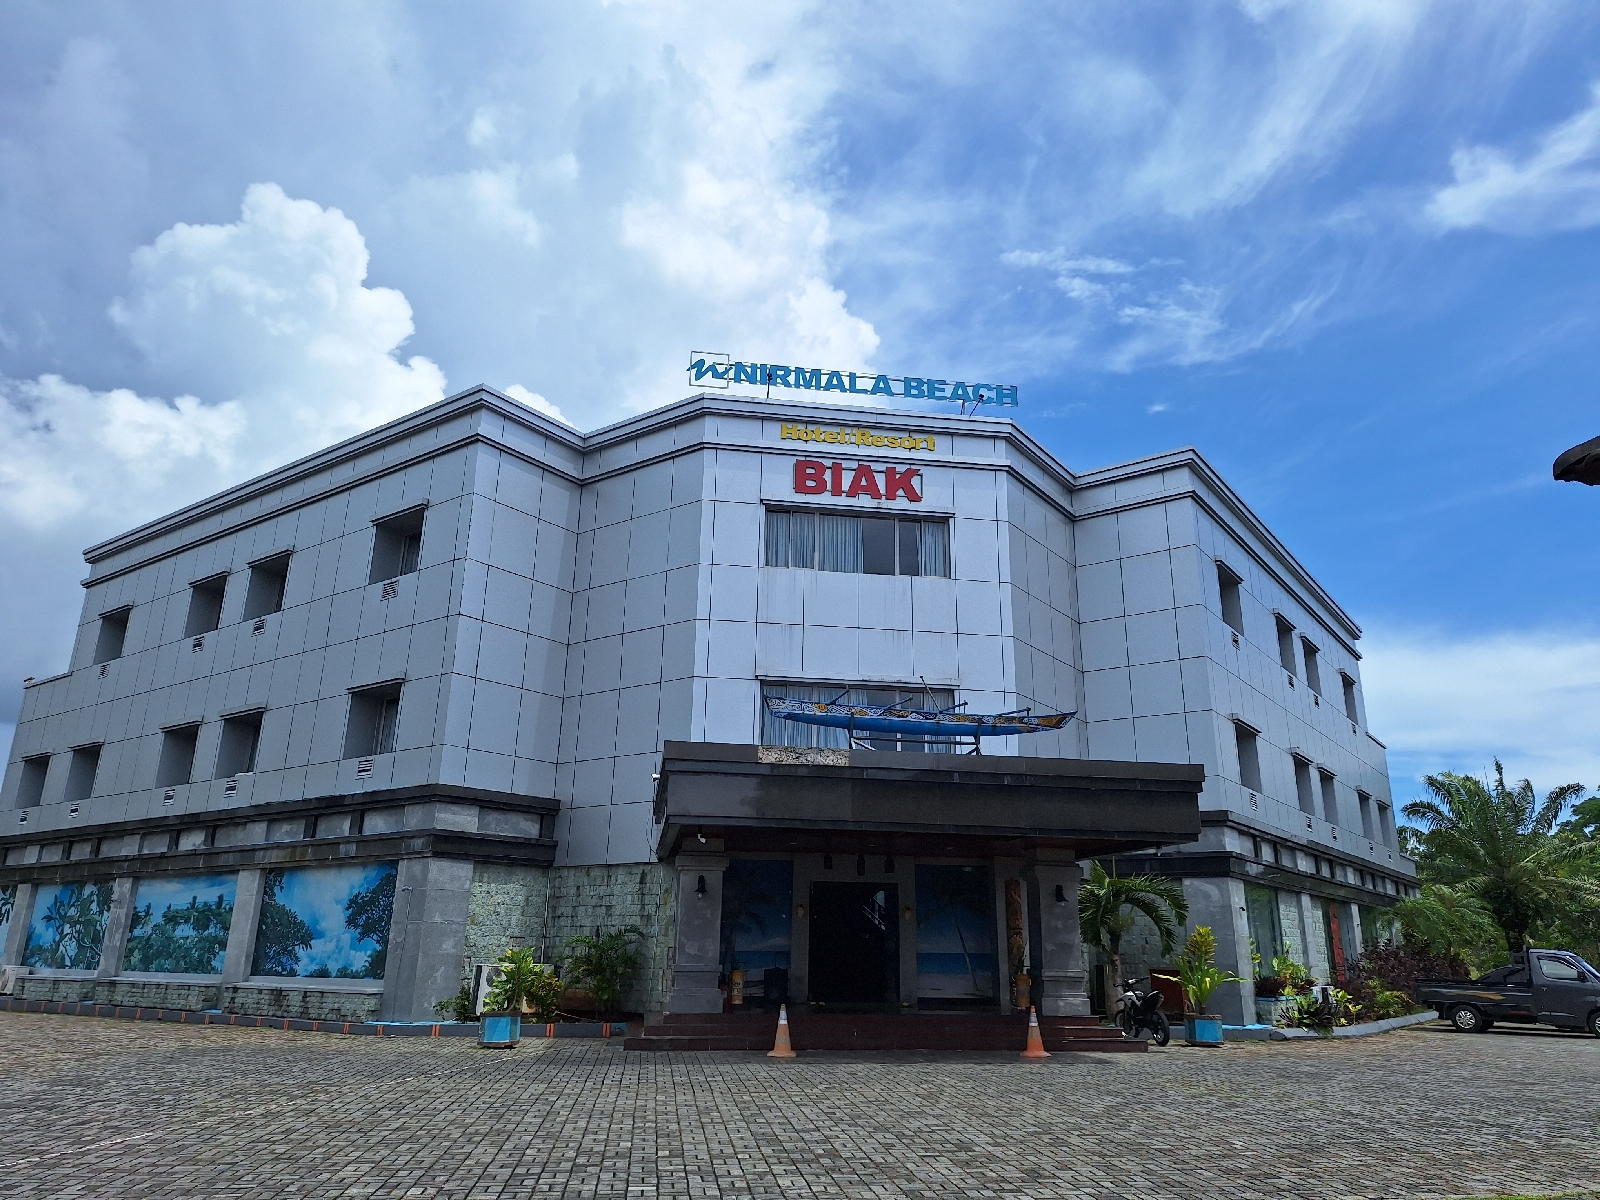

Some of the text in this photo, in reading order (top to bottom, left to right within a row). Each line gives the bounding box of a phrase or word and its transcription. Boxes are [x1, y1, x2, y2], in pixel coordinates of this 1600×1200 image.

[733, 361, 1018, 407] NIRMALA BEACH
[794, 459, 923, 502] BIAK
